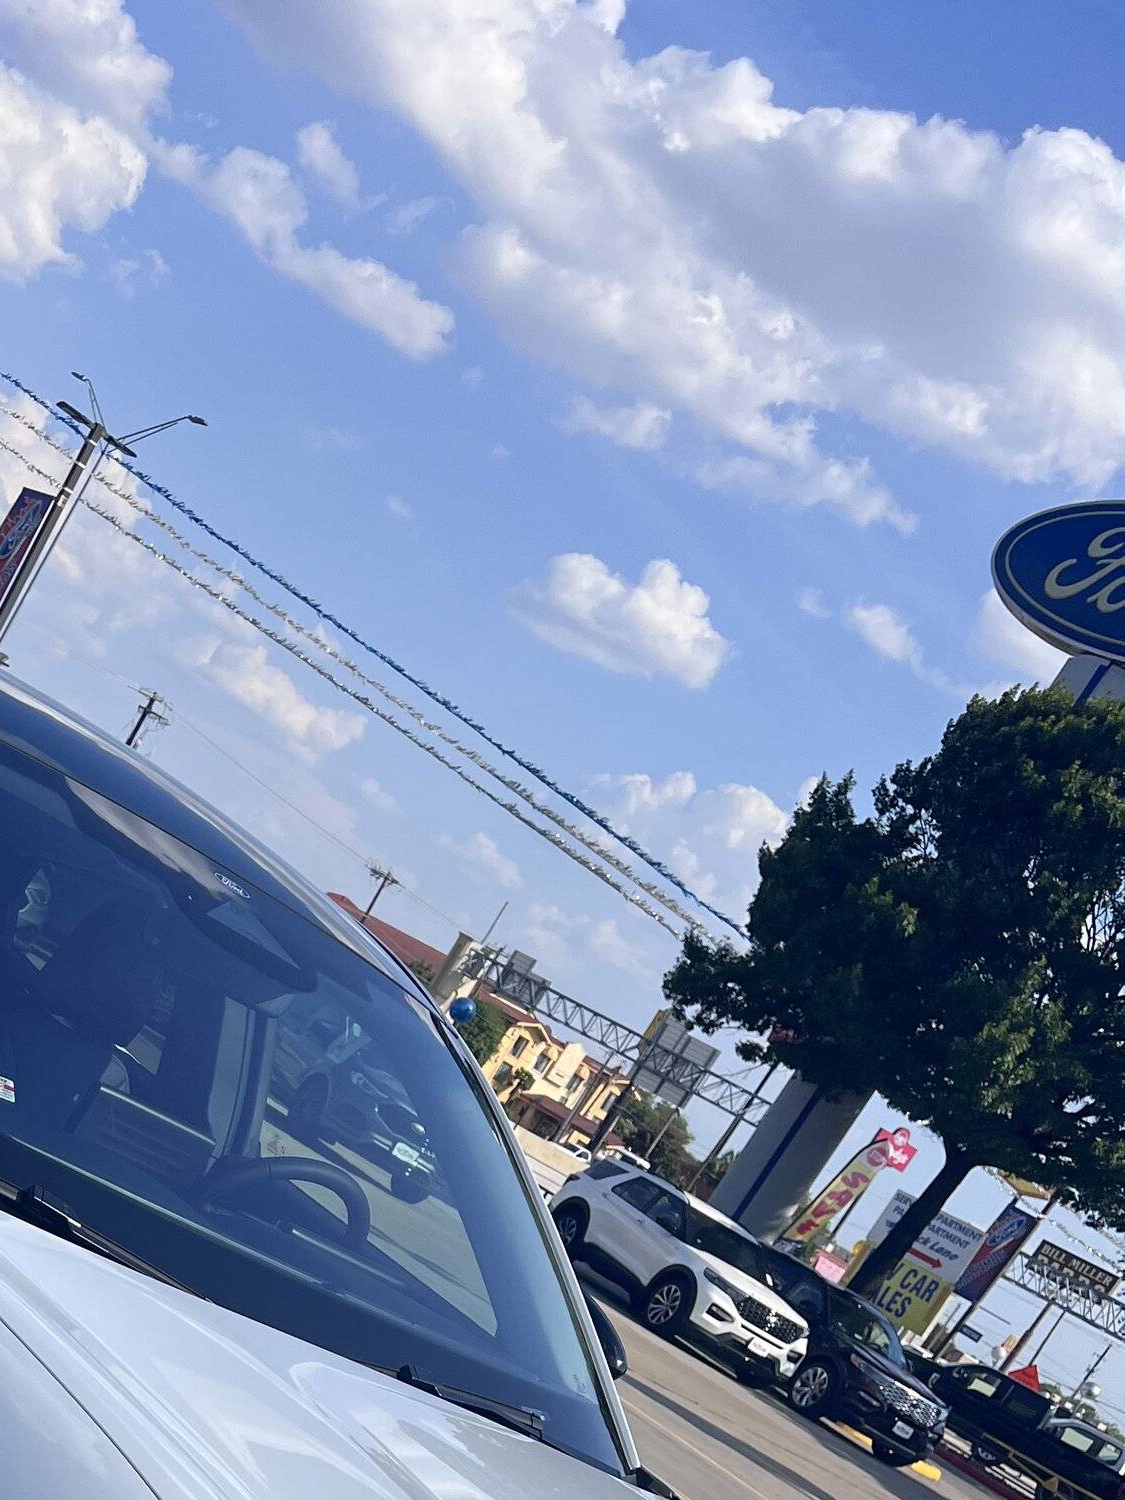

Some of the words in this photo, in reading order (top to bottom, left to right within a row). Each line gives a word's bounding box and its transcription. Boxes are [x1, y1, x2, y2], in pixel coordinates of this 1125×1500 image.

[1041, 1243, 1066, 1264] BILL
[1068, 1258, 1114, 1287] MILLER
[900, 1268, 940, 1302] CAR
